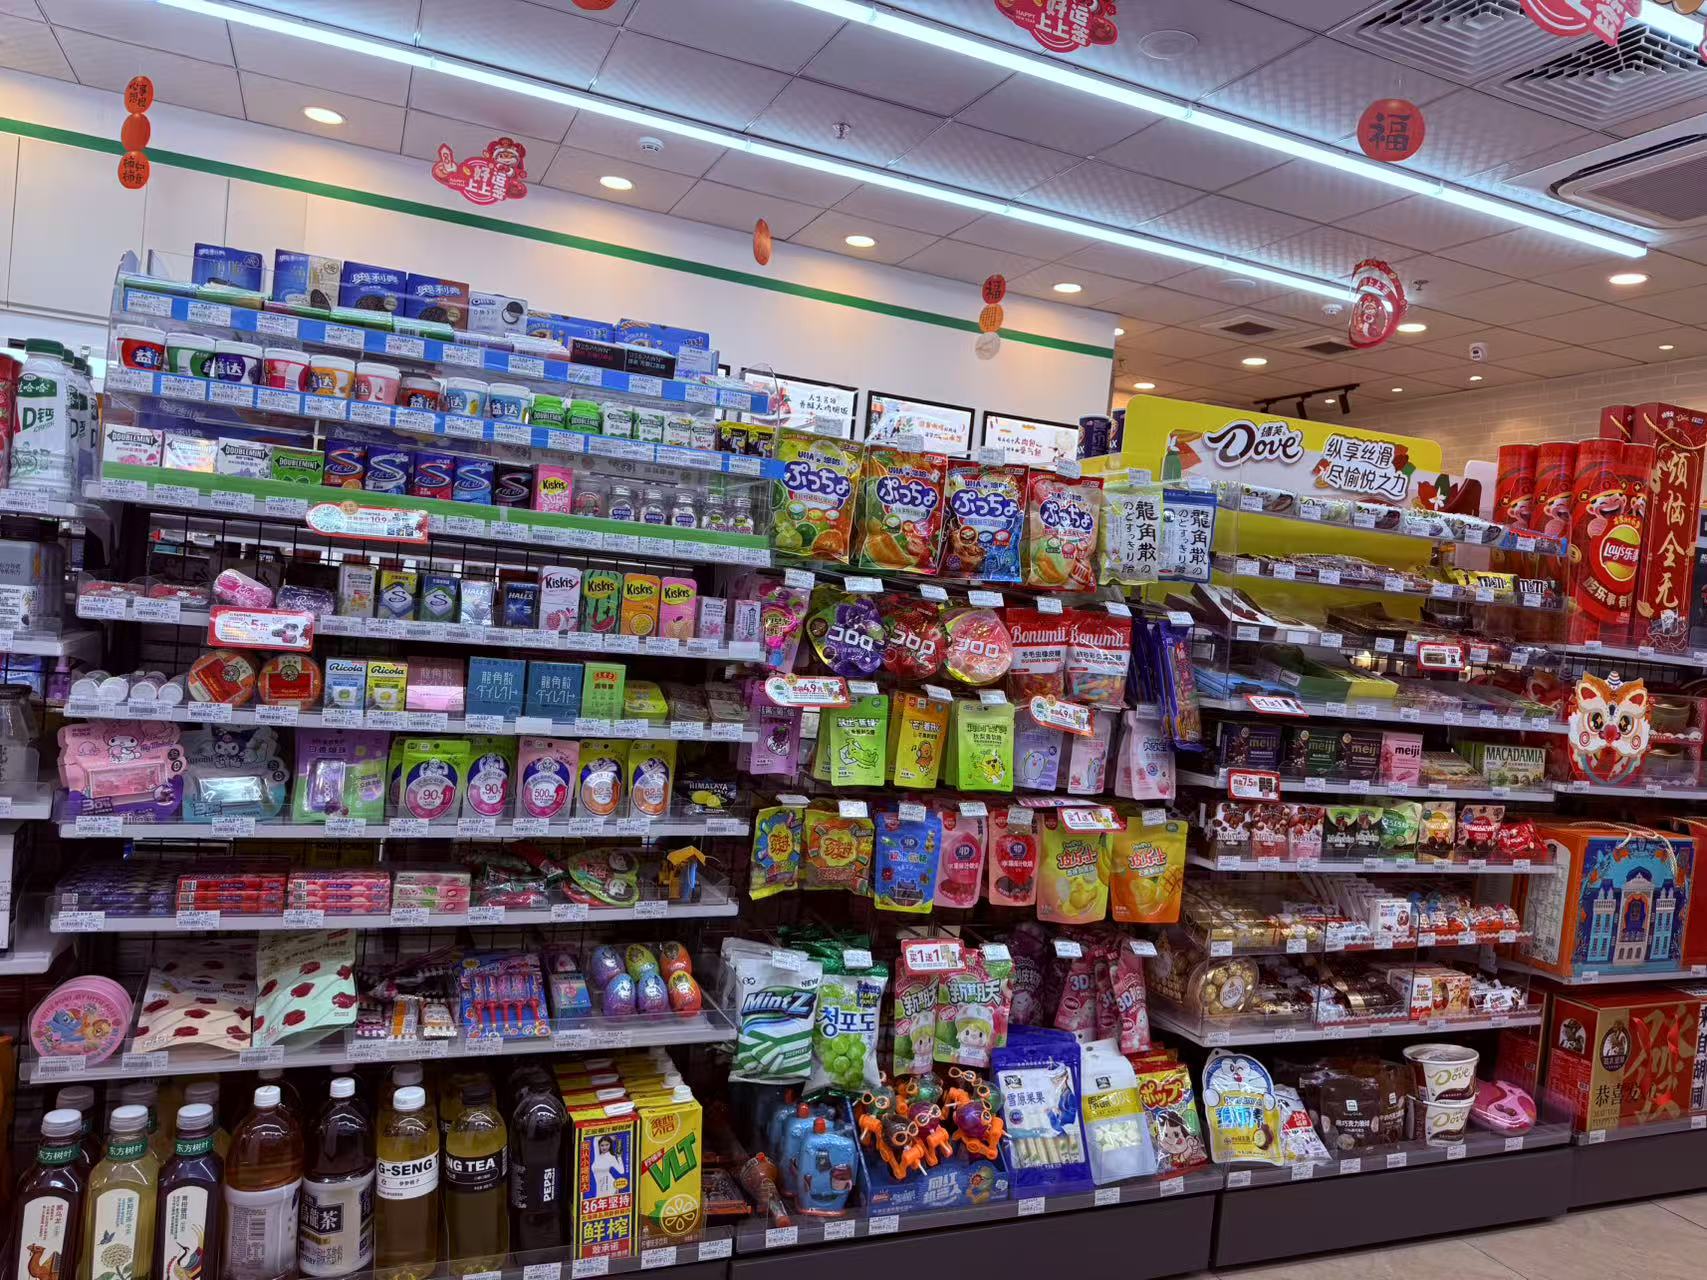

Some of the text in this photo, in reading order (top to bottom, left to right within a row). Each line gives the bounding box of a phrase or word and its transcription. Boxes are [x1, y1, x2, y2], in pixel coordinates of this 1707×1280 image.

[1370, 112, 1410, 151] 福
[490, 400, 518, 417] 益达
[112, 431, 154, 445] DOUBLEMINT
[1207, 422, 1299, 462] Dove
[225, 445, 265, 459] DOUBLEMINT
[1327, 437, 1395, 467] 纵享丝滑
[279, 457, 318, 470] DOUBLEMINT
[543, 479, 566, 490] Kiskis
[784, 463, 849, 498] ぷっちょ
[1327, 465, 1407, 492] 尽愉悦之力
[880, 478, 936, 505] ぷっちょ
[955, 492, 1017, 516] ぷっちょ
[1044, 502, 1091, 527] ぷっちょ
[1656, 450, 1691, 608] 烦恼全无
[1134, 500, 1160, 576] 龍角散の
[1604, 542, 1625, 560] Lay's
[545, 577, 576, 589] Kiskis
[587, 580, 615, 592] Kiskis
[626, 583, 653, 595] Kiskis
[464, 588, 489, 596] HALLS
[508, 591, 533, 600] HALLS
[664, 587, 690, 599] Kiskis
[1011, 625, 1068, 644] Bonumii
[1022, 650, 1061, 658] 毛毛虫橡皮糖
[329, 662, 363, 673] Ricola
[371, 664, 405, 676] Ricola
[481, 671, 514, 686] 龍角散
[540, 675, 572, 689] 龍角散
[1395, 746, 1420, 758] meiji
[1486, 746, 1544, 763] MACADAMIA
[689, 782, 728, 791] HIMALAYA
[959, 847, 970, 856] 4D
[1013, 845, 1023, 853] 4D
[910, 949, 940, 962] 买1送1
[801, 978, 818, 988] NEW
[1070, 974, 1089, 990] 3D
[743, 991, 815, 1017] MintZ
[1116, 991, 1133, 1012] 3D
[821, 1008, 875, 1038] 청포도
[1427, 1068, 1470, 1086] Dove
[1140, 1078, 1184, 1107] ポップ
[1427, 1111, 1466, 1127] Dove
[109, 1144, 143, 1157] 东方树叶
[176, 1141, 209, 1153] 东方树叶
[38, 1149, 72, 1161] 东方树叶
[648, 1132, 696, 1192] VLT
[378, 1158, 433, 1177] G-SENG
[465, 1157, 496, 1172] TEA
[543, 1167, 553, 1202] PEPSI
[582, 1194, 630, 1214] 36年坚持
[583, 1216, 629, 1244] 鲜榨
[592, 1243, 619, 1254] 敢承诺
